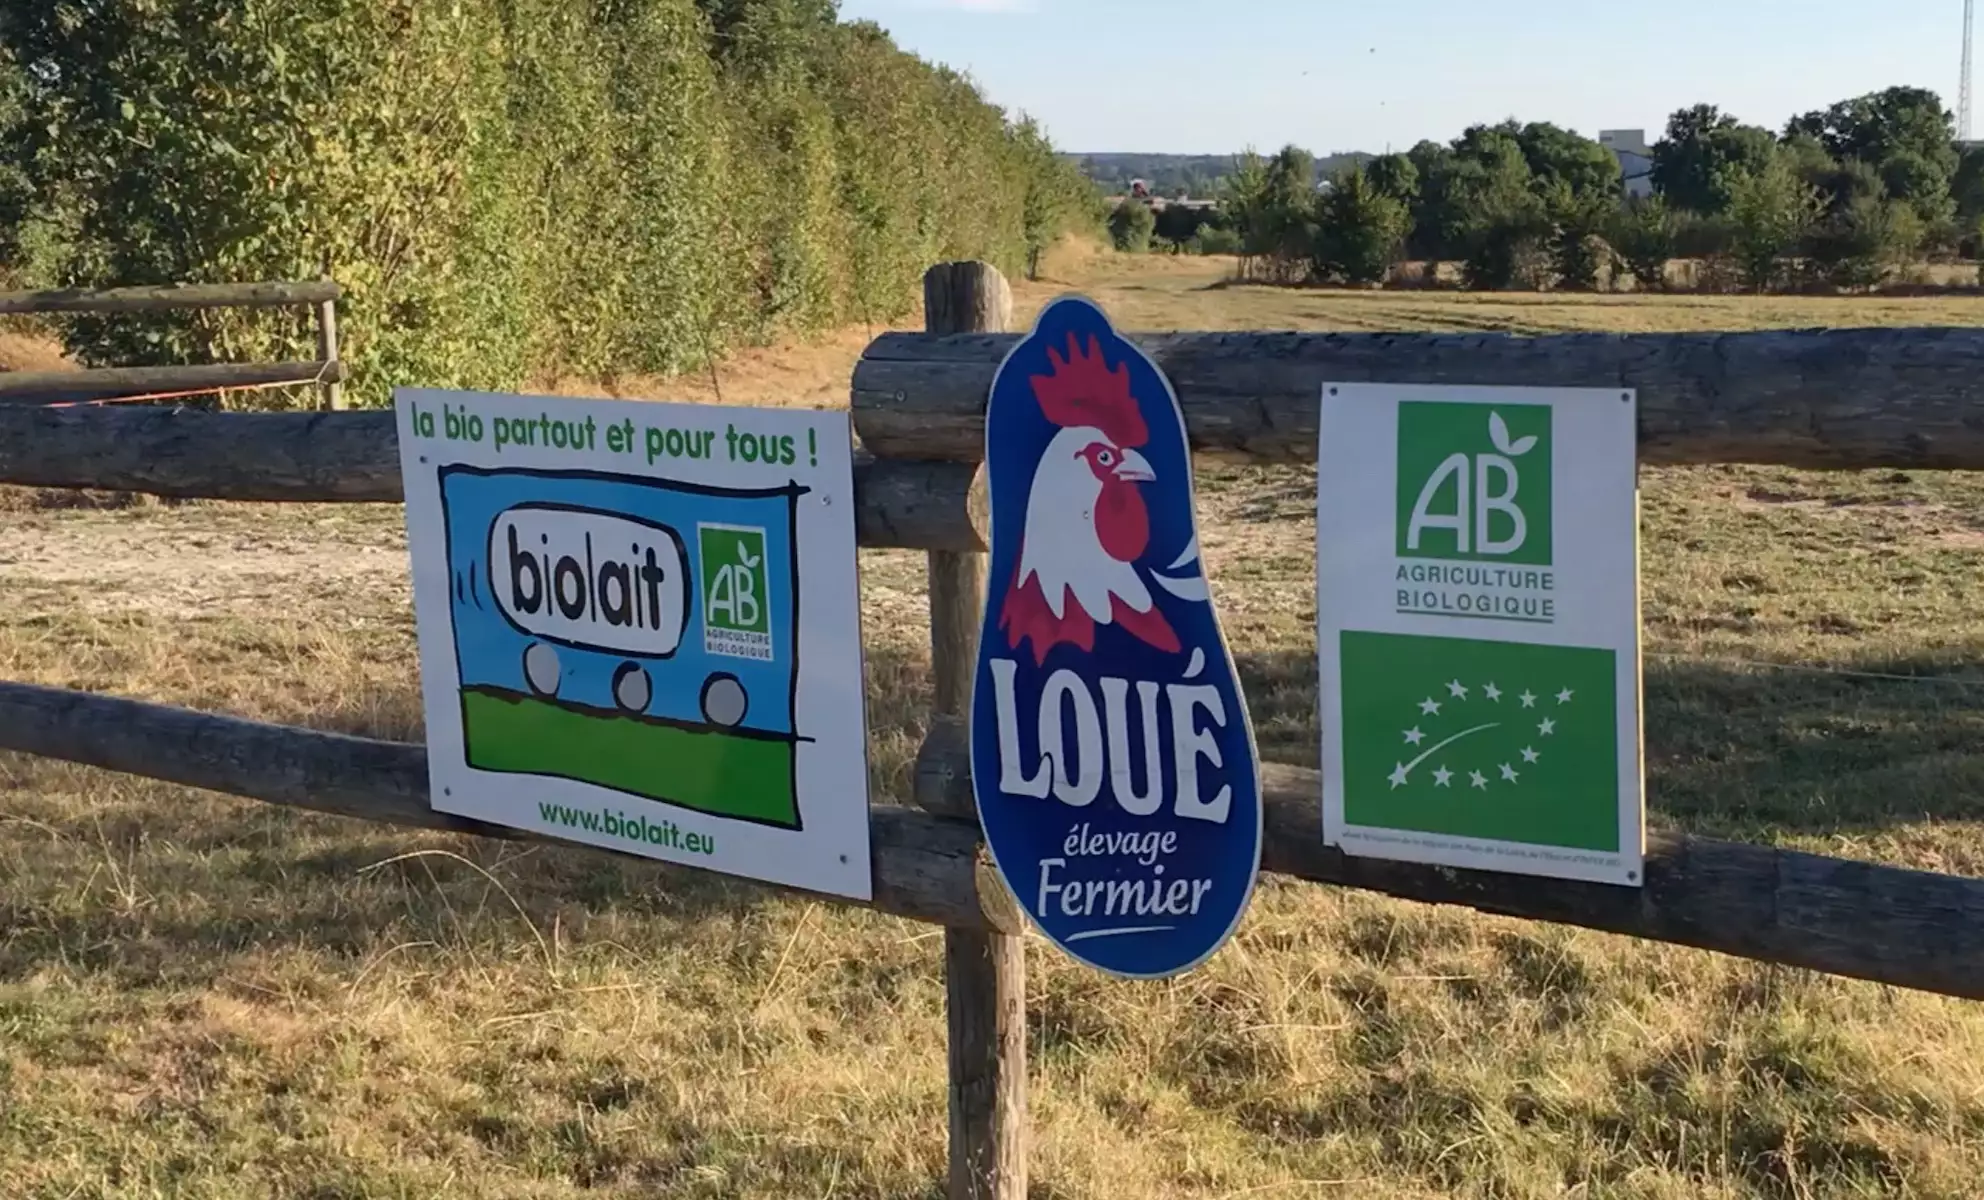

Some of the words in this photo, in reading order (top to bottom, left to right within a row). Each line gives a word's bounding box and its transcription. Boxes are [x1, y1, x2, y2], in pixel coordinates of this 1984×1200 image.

[411, 402, 435, 438] la
[444, 404, 483, 442] bio
[494, 413, 597, 451] partout
[606, 418, 634, 453] et
[646, 426, 716, 464] pour
[726, 425, 797, 465] tous
[807, 428, 818, 467] !
[1407, 452, 1527, 554] AB
[507, 524, 664, 631] biolait
[708, 564, 759, 626] AB
[1396, 565, 1554, 591] AGRICULTURE
[1396, 590, 1554, 617] BIOLOGIQUE
[707, 628, 769, 646] AGRICULTURE
[707, 641, 770, 658] BIOLOGIQUE
[989, 646, 1232, 824] LOUÉ
[538, 801, 715, 856] www.biolait.eu
[1063, 823, 1178, 865] élevage
[1038, 858, 1212, 917] Fermier
